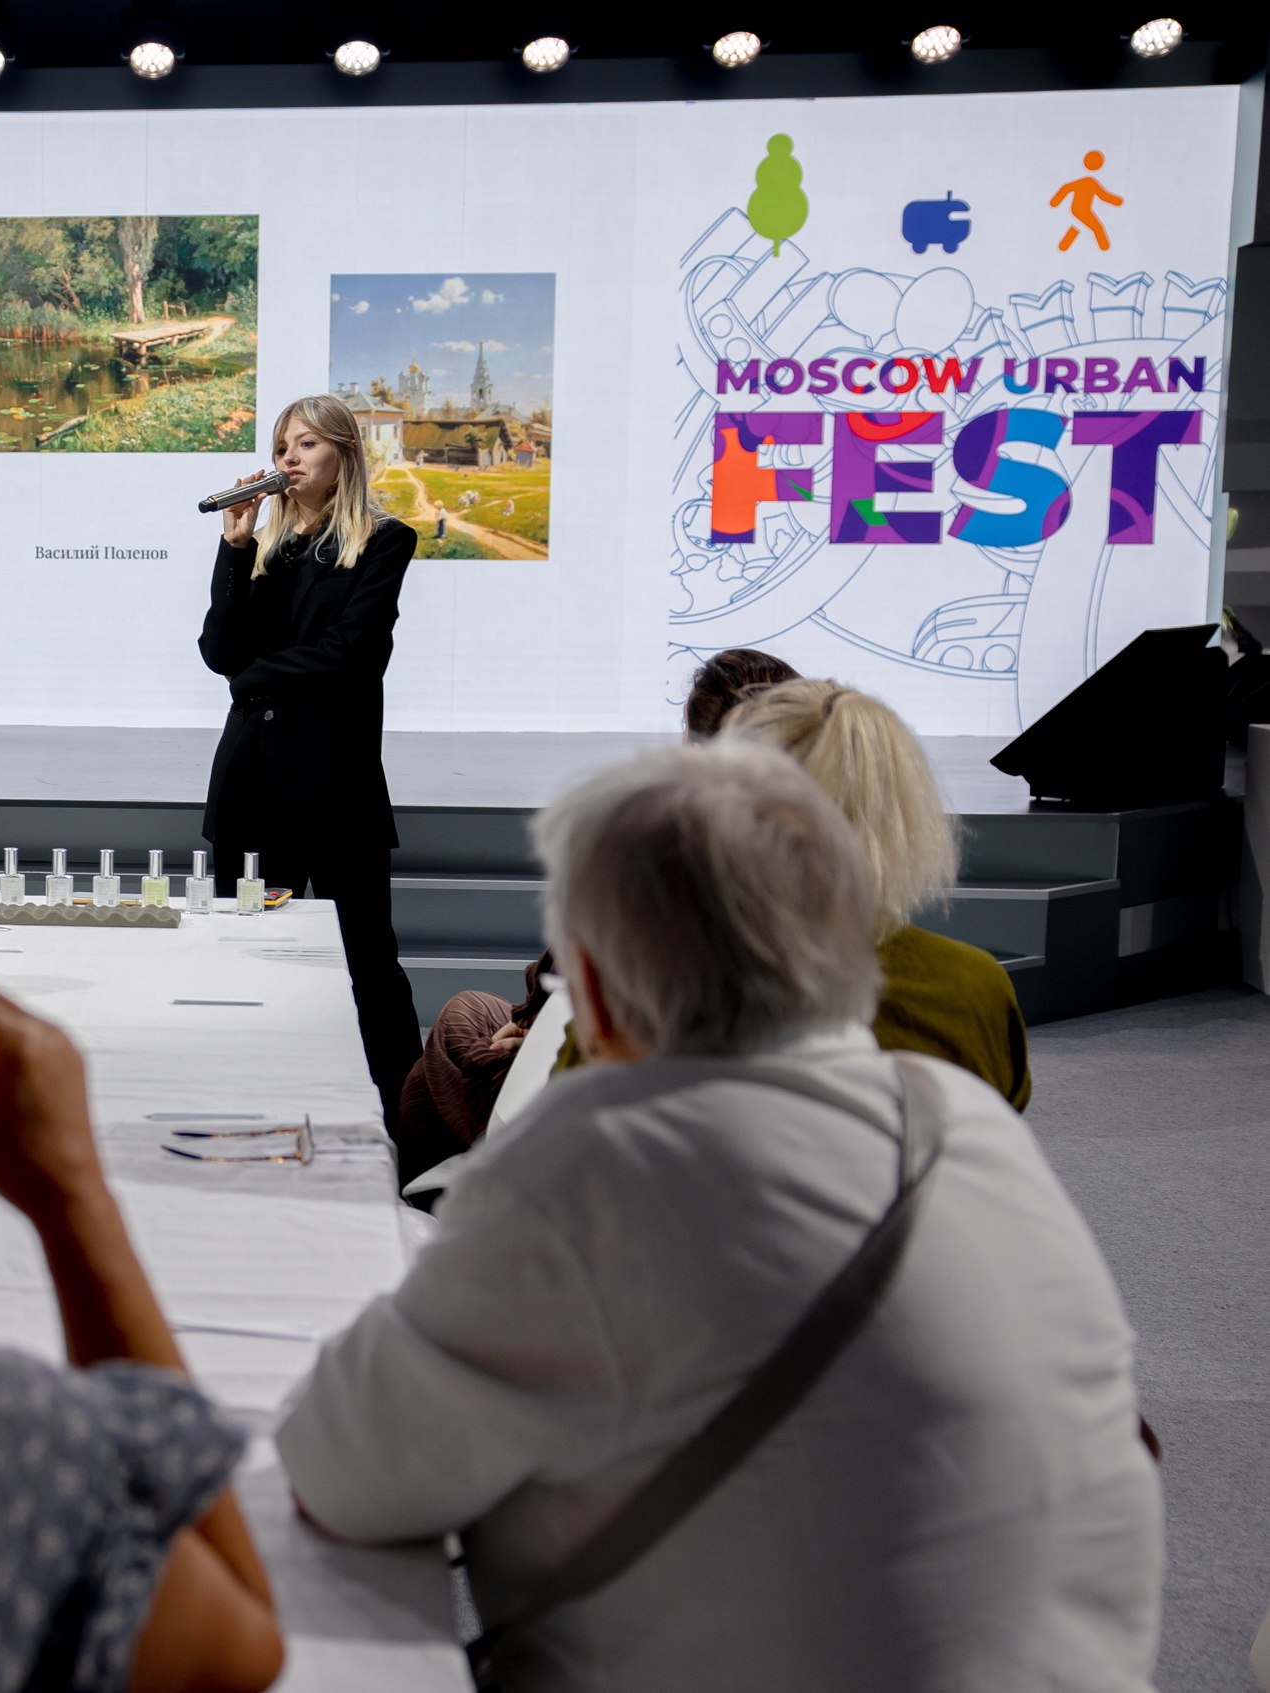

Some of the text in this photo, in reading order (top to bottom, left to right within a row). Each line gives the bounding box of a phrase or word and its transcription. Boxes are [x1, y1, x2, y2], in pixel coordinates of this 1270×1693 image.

[717, 355, 1206, 395] MOSCOW URBAN
[711, 407, 1202, 548] FEST
[35, 545, 169, 560] Василий Поленов
